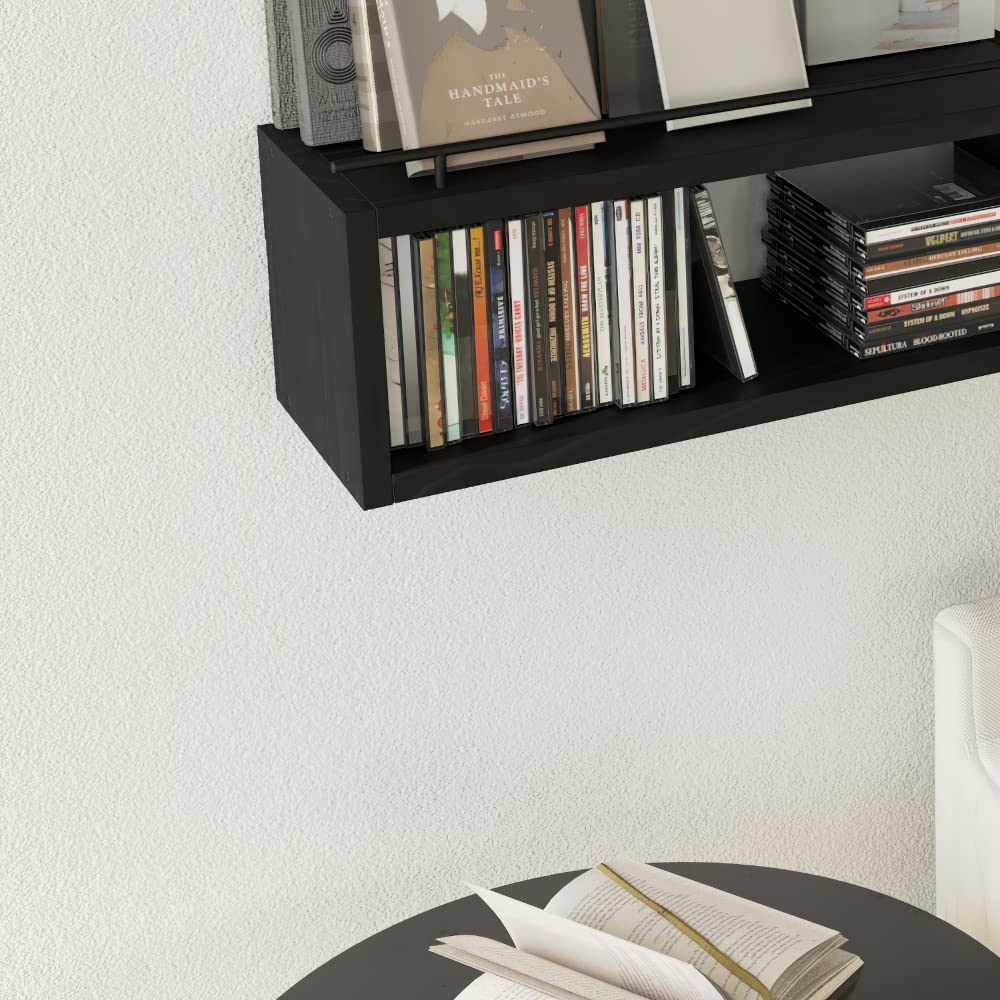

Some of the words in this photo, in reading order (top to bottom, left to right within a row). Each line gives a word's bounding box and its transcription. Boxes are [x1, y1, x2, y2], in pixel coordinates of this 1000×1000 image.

[488, 71, 507, 81] THE
[447, 76, 551, 100] HANDMAID'S
[484, 92, 522, 108] TALE
[903, 317, 925, 328] SYSTEM
[864, 340, 908, 357] SEPULTURA
